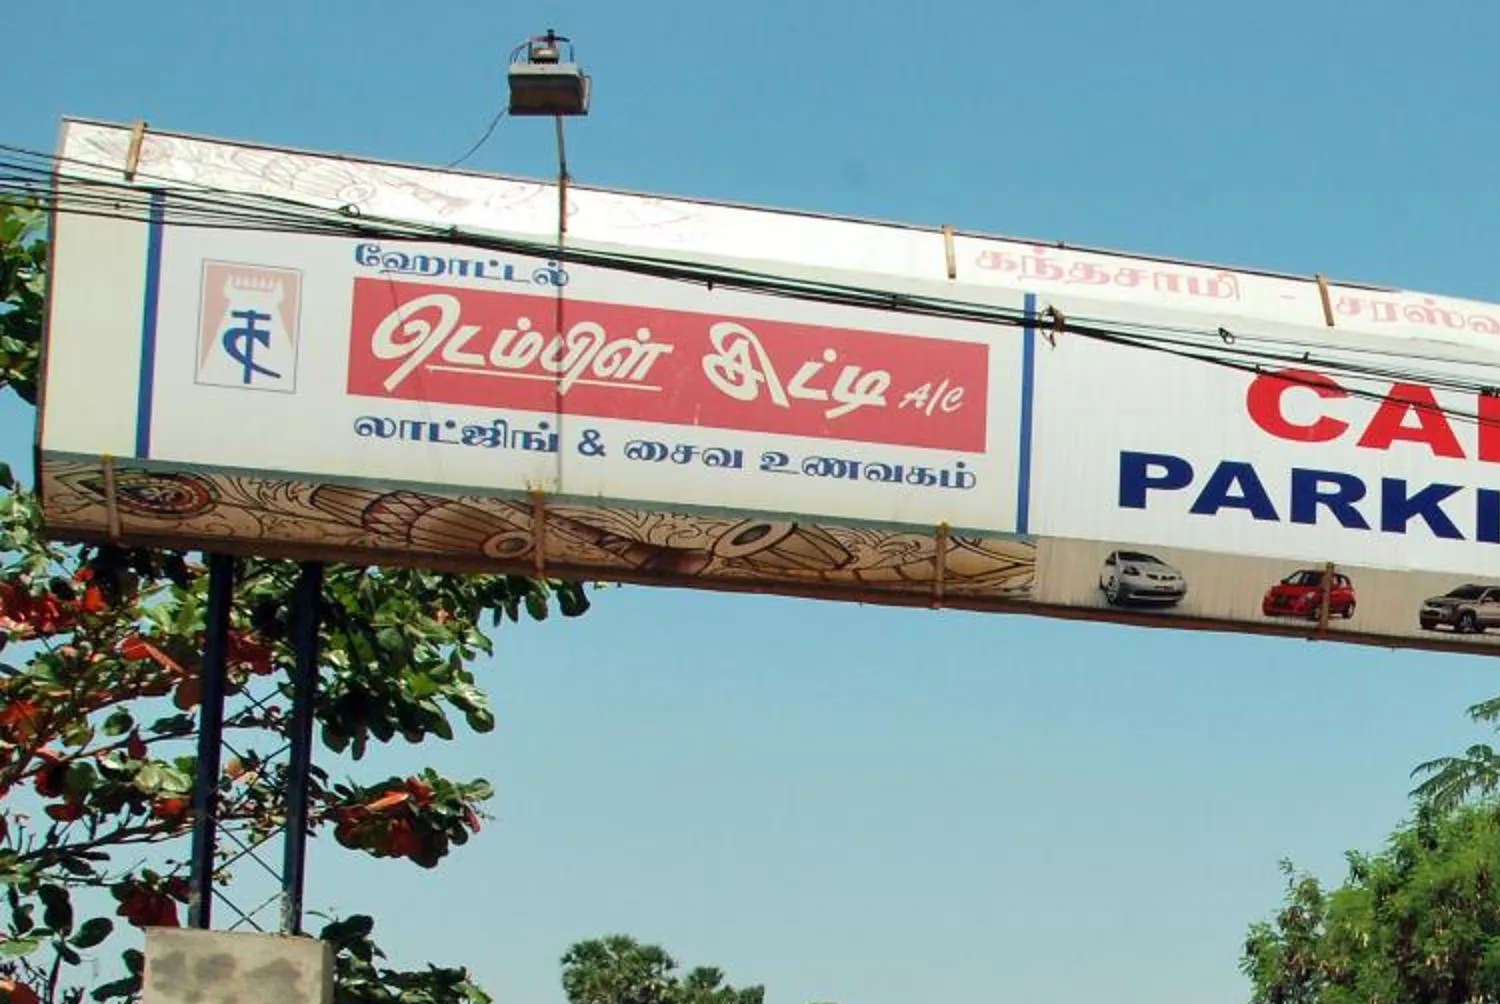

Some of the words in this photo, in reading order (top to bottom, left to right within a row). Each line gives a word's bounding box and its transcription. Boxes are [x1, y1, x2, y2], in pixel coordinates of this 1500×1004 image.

[355, 243, 569, 287] ஹோட்டல்
[975, 246, 1240, 300] கந்தசாமி
[899, 379, 965, 416] A/C
[354, 415, 560, 452] லாட்ஜிங்
[577, 430, 606, 457] &
[624, 438, 743, 469] சைவ
[760, 451, 976, 488] உணவகம்
